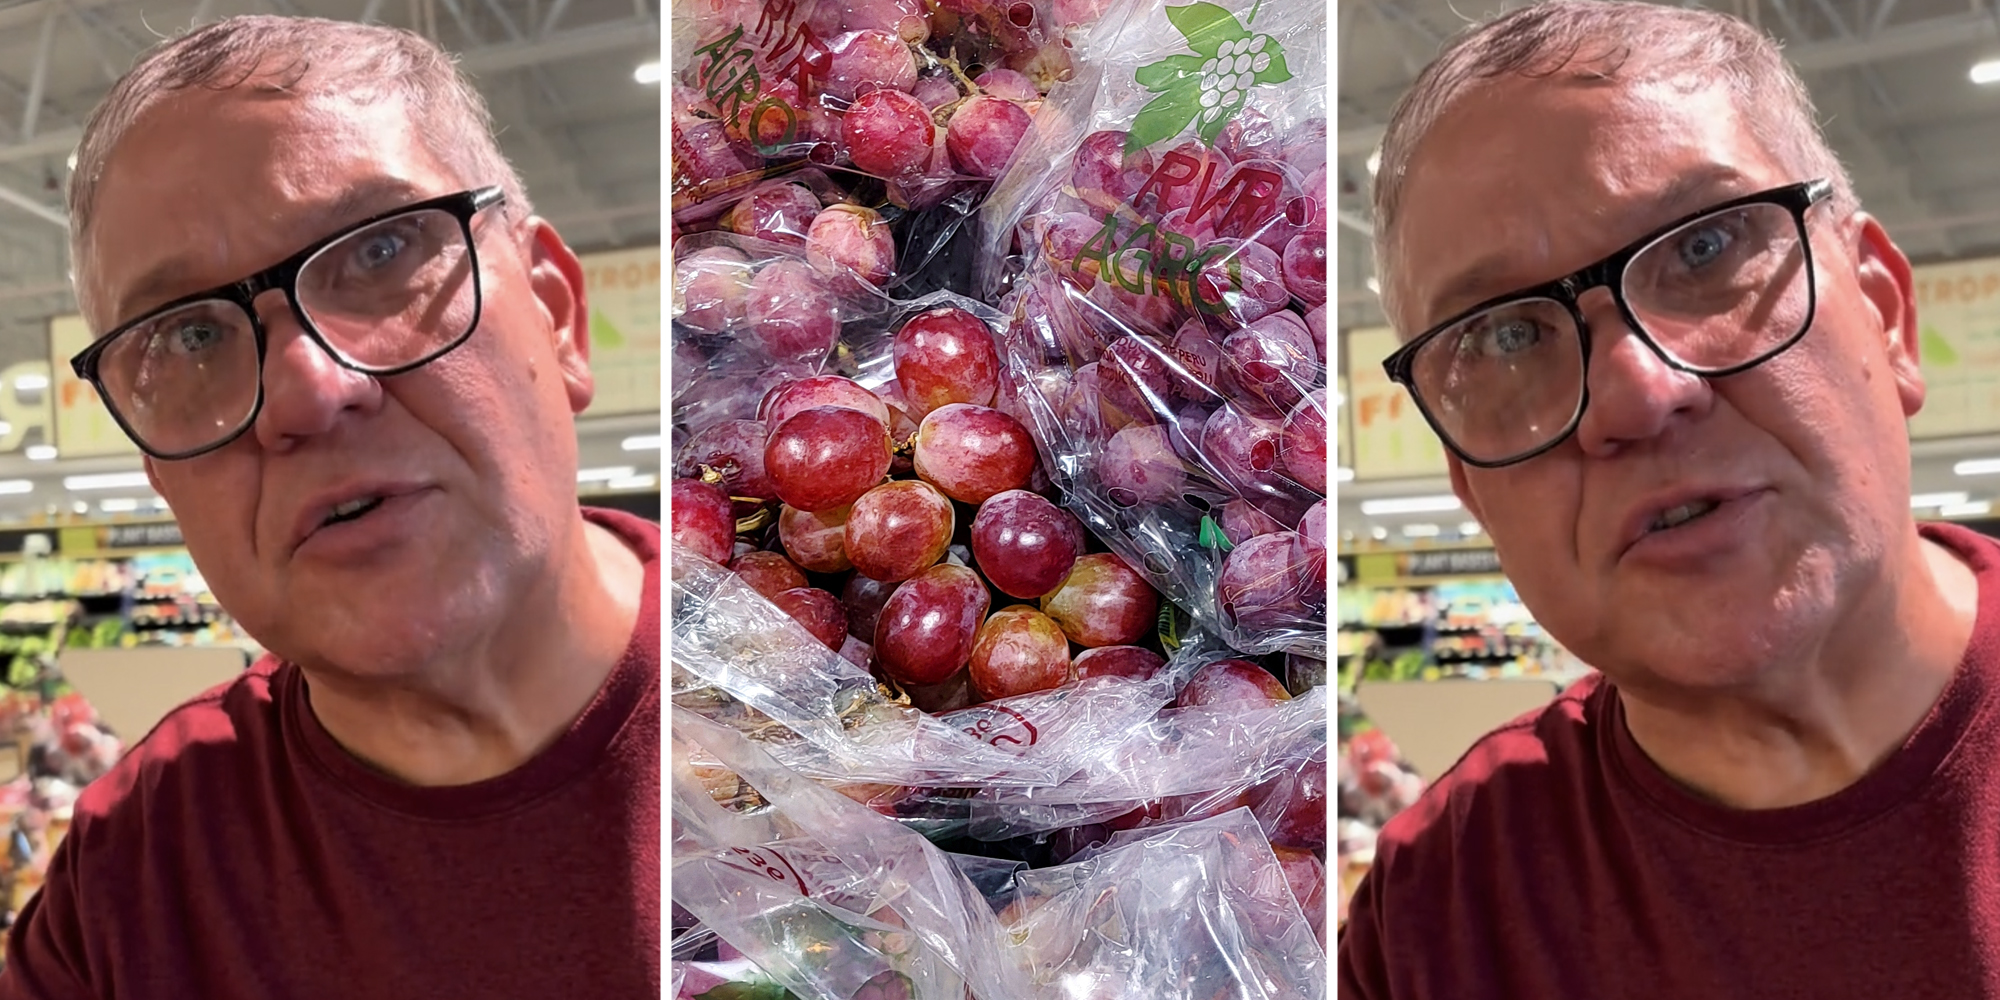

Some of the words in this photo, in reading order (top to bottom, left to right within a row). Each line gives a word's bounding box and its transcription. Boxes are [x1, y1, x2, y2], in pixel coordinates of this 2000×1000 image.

[693, 22, 797, 155] AGRO
[1133, 151, 1282, 237] RVR
[1072, 214, 1243, 314] AGRO
